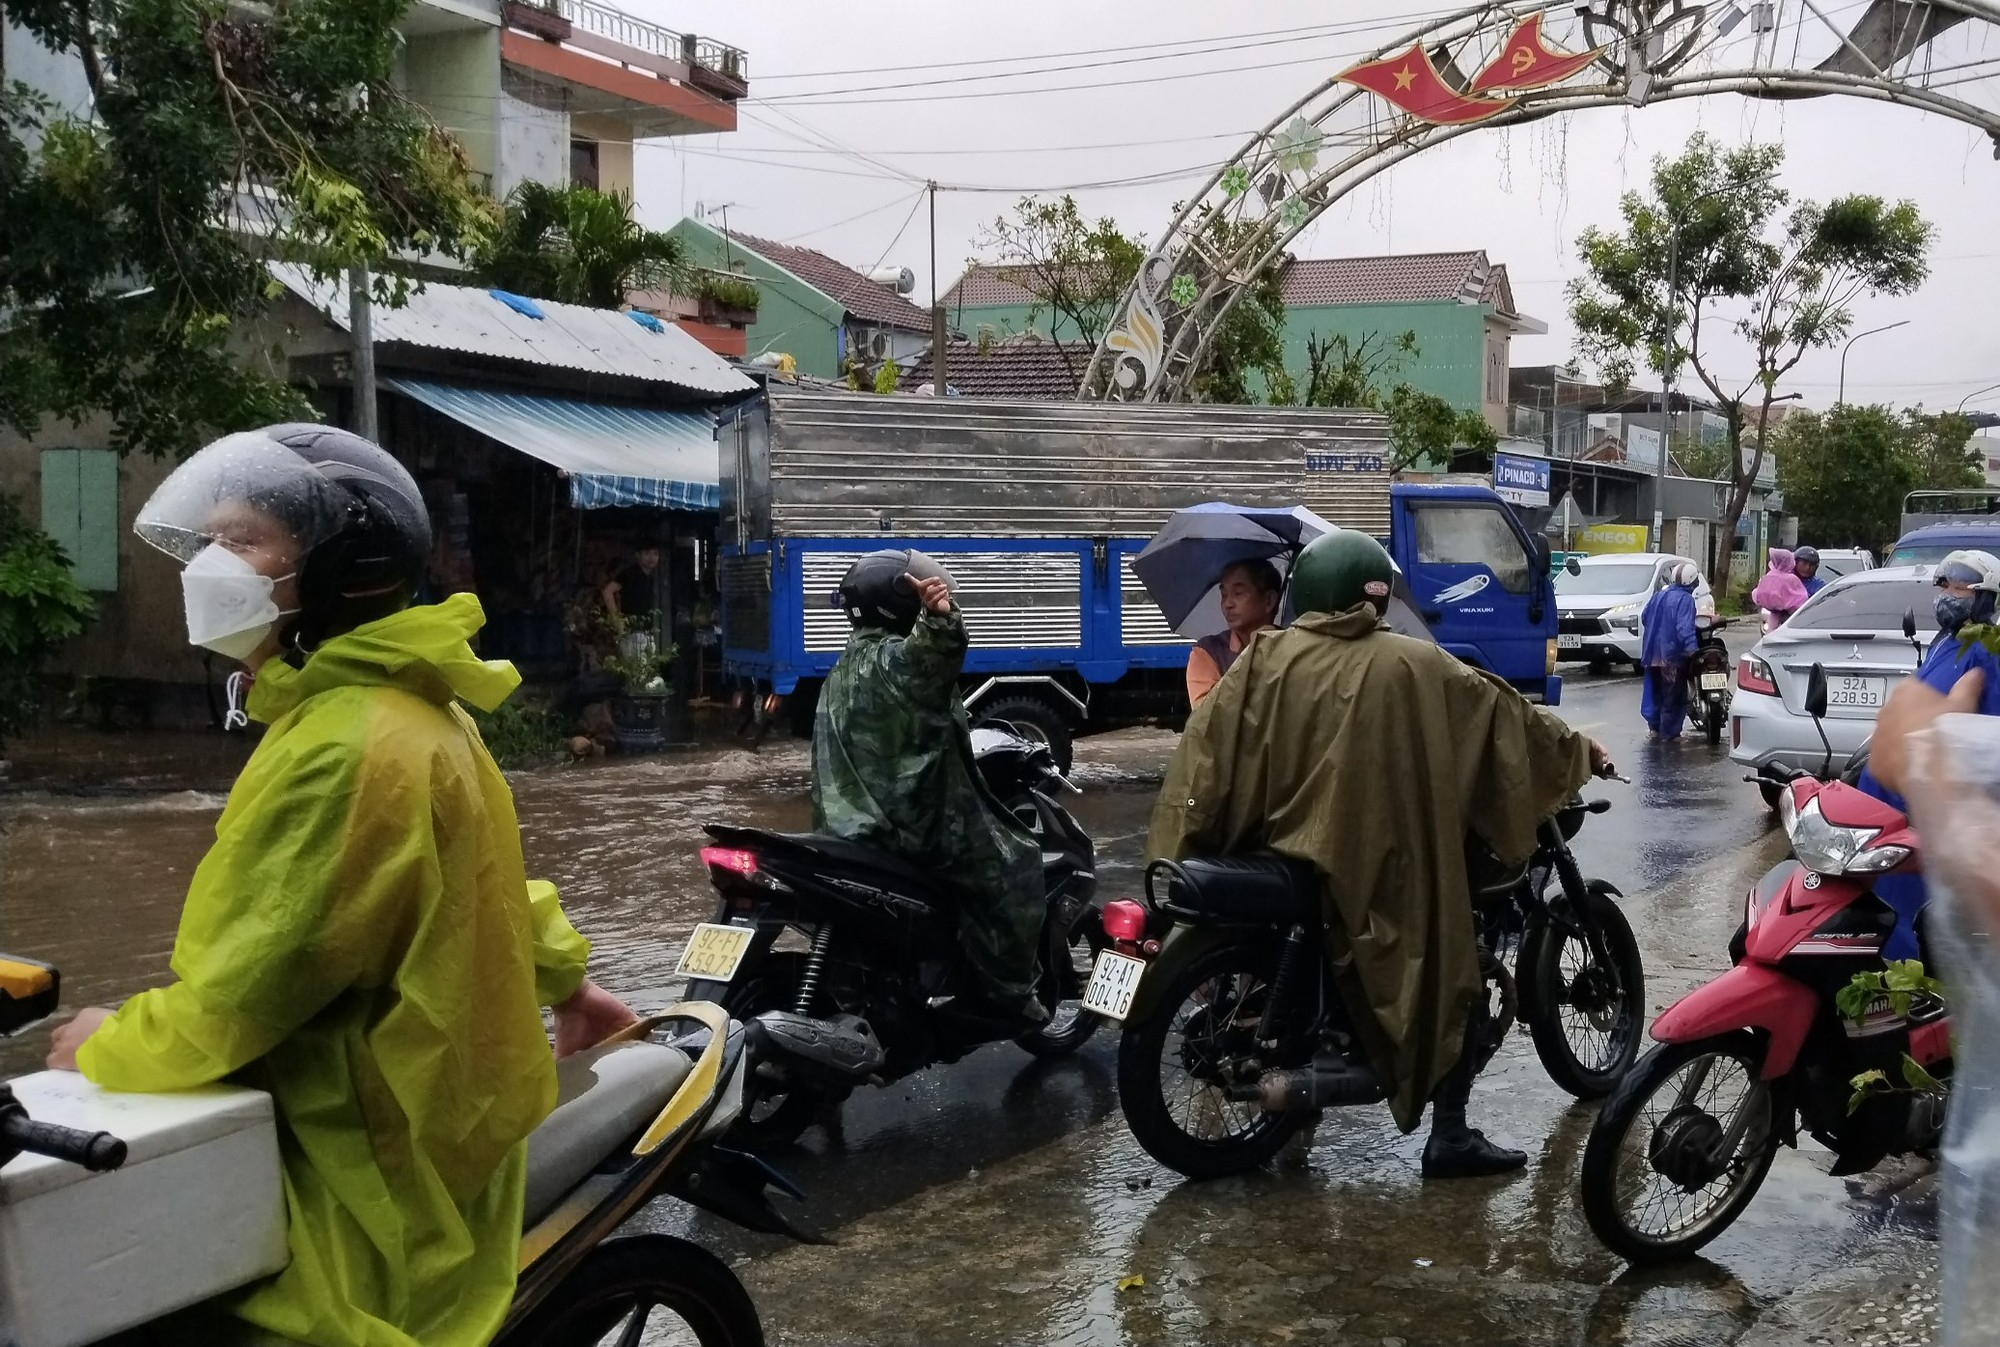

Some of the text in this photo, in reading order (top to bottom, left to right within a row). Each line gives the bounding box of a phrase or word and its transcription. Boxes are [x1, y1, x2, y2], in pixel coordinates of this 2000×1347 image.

[1504, 467, 1535, 485] PINACO
[1583, 530, 1637, 545] ENEOS
[1843, 677, 1867, 691] 92A
[1832, 691, 1877, 705] 238.93
[1087, 981, 1131, 1015] 004.16
